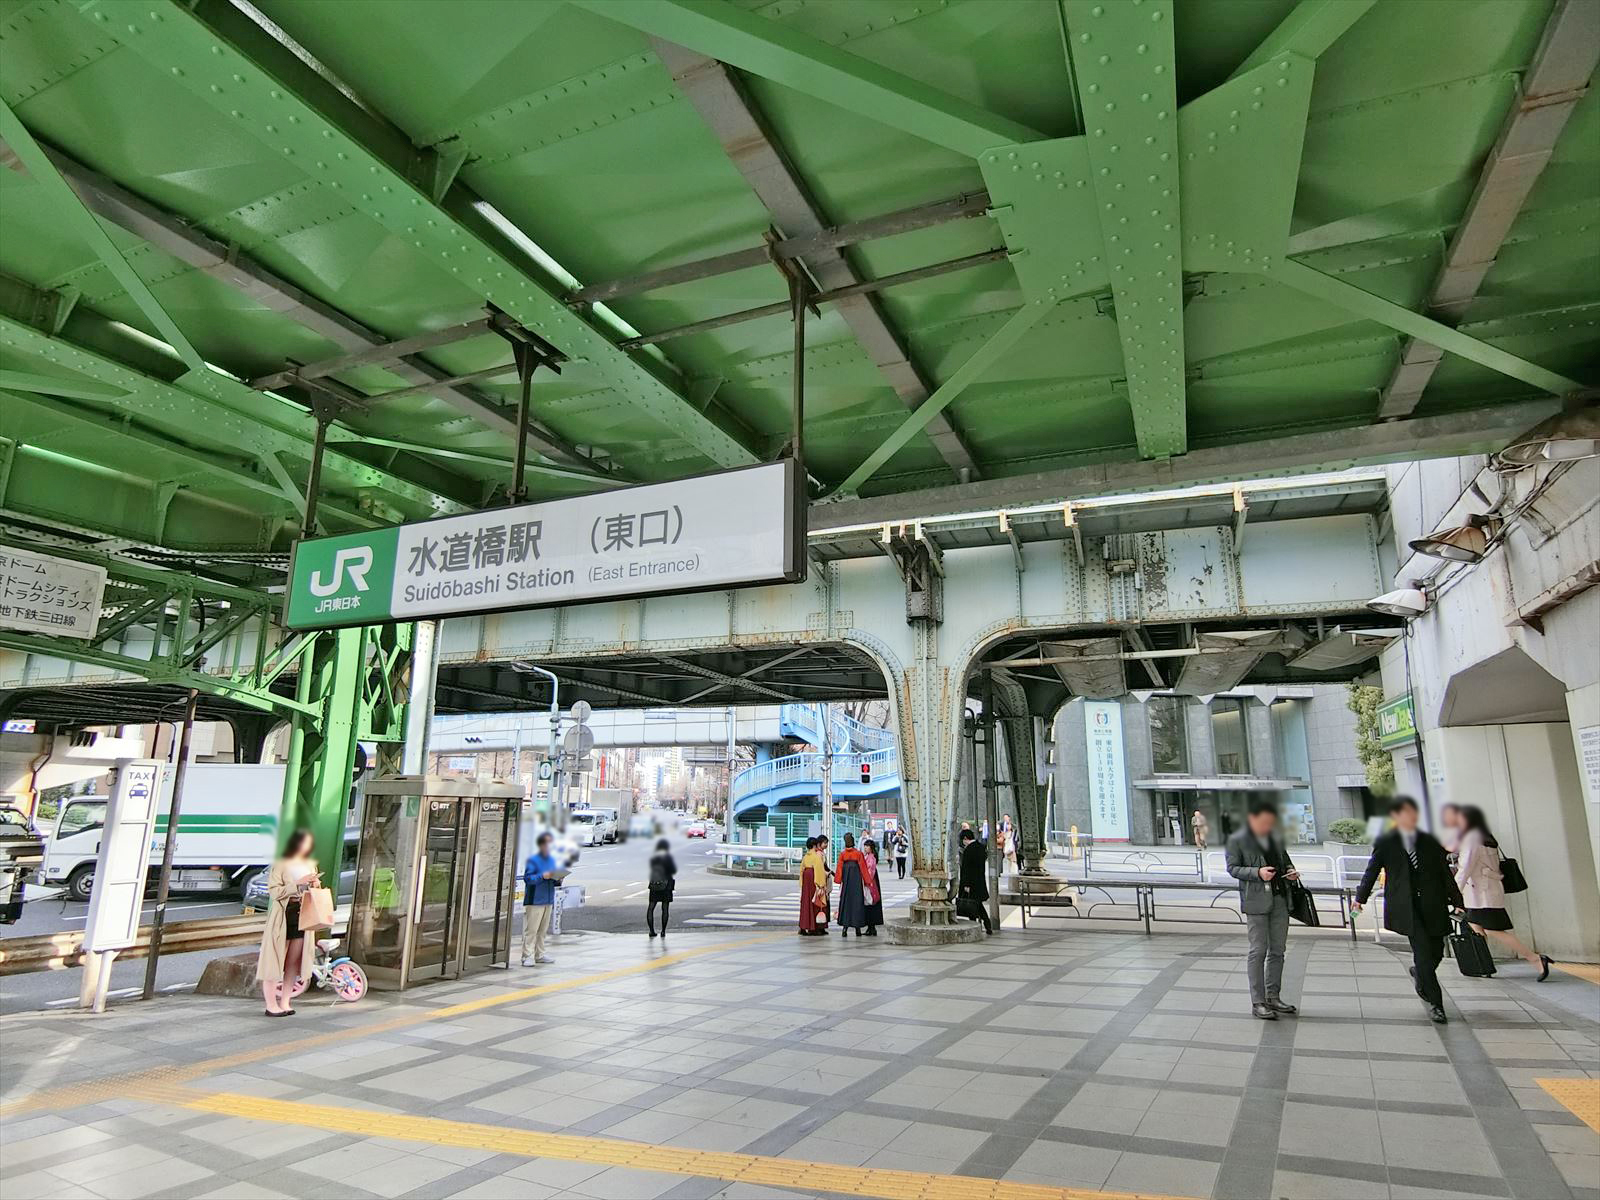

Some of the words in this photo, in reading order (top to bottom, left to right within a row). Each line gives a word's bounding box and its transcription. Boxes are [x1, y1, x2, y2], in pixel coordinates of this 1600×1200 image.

[407, 520, 543, 577] 水道橋駅
[591, 505, 683, 554] （東口）
[310, 545, 374, 597] JR
[404, 574, 500, 603] Suidōbashi
[506, 567, 574, 591] Station
[588, 564, 624, 583] (East
[629, 553, 700, 577] Entrance)
[315, 595, 361, 613] JR東日本
